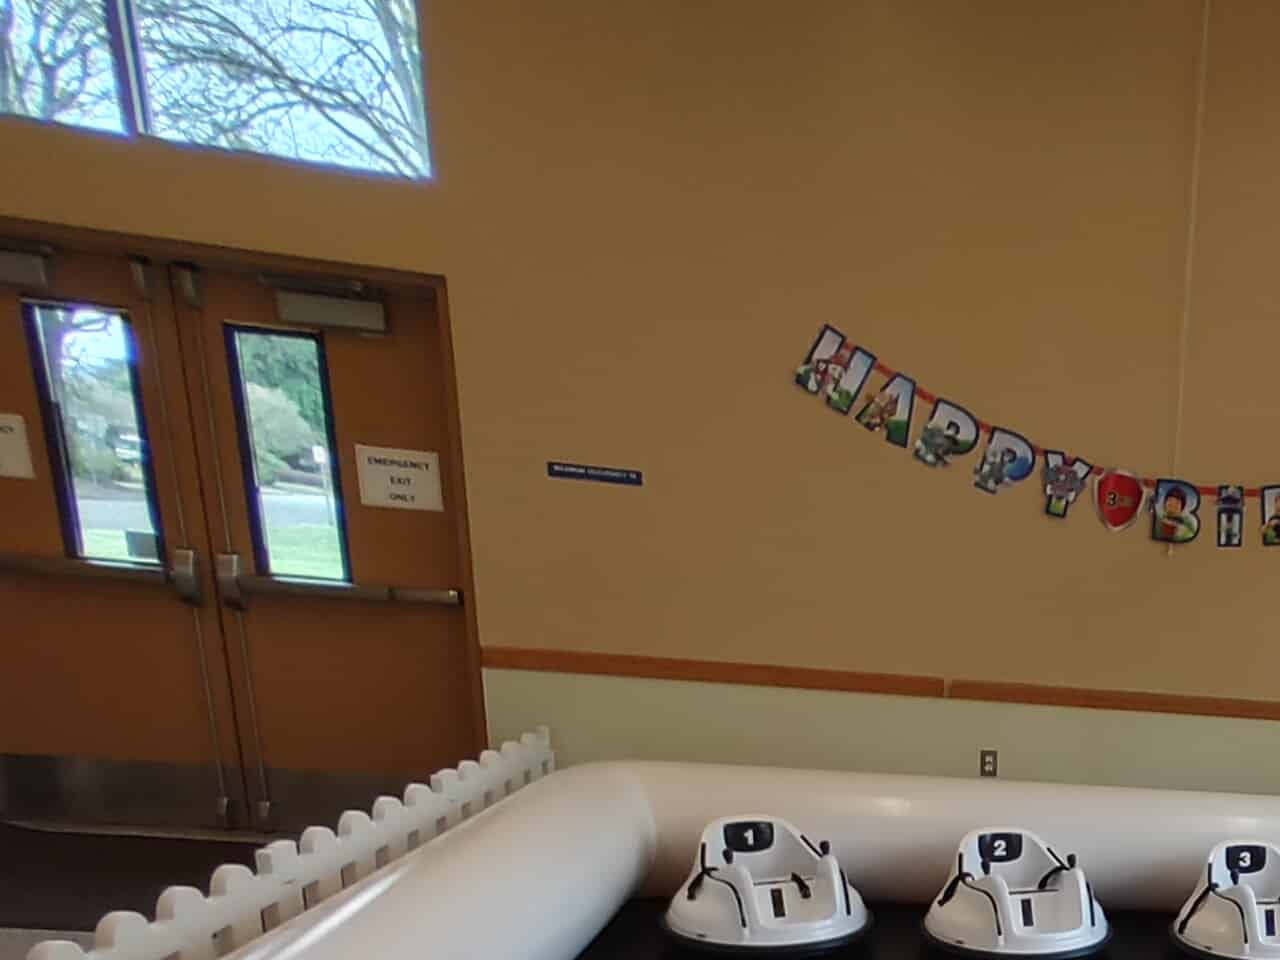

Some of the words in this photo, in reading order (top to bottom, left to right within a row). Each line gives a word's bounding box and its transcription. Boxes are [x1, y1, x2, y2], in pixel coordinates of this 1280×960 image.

[795, 323, 1093, 519] HAPPY
[743, 829, 754, 846] 1
[992, 839, 1007, 857] 2
[1239, 851, 1251, 867] 3
